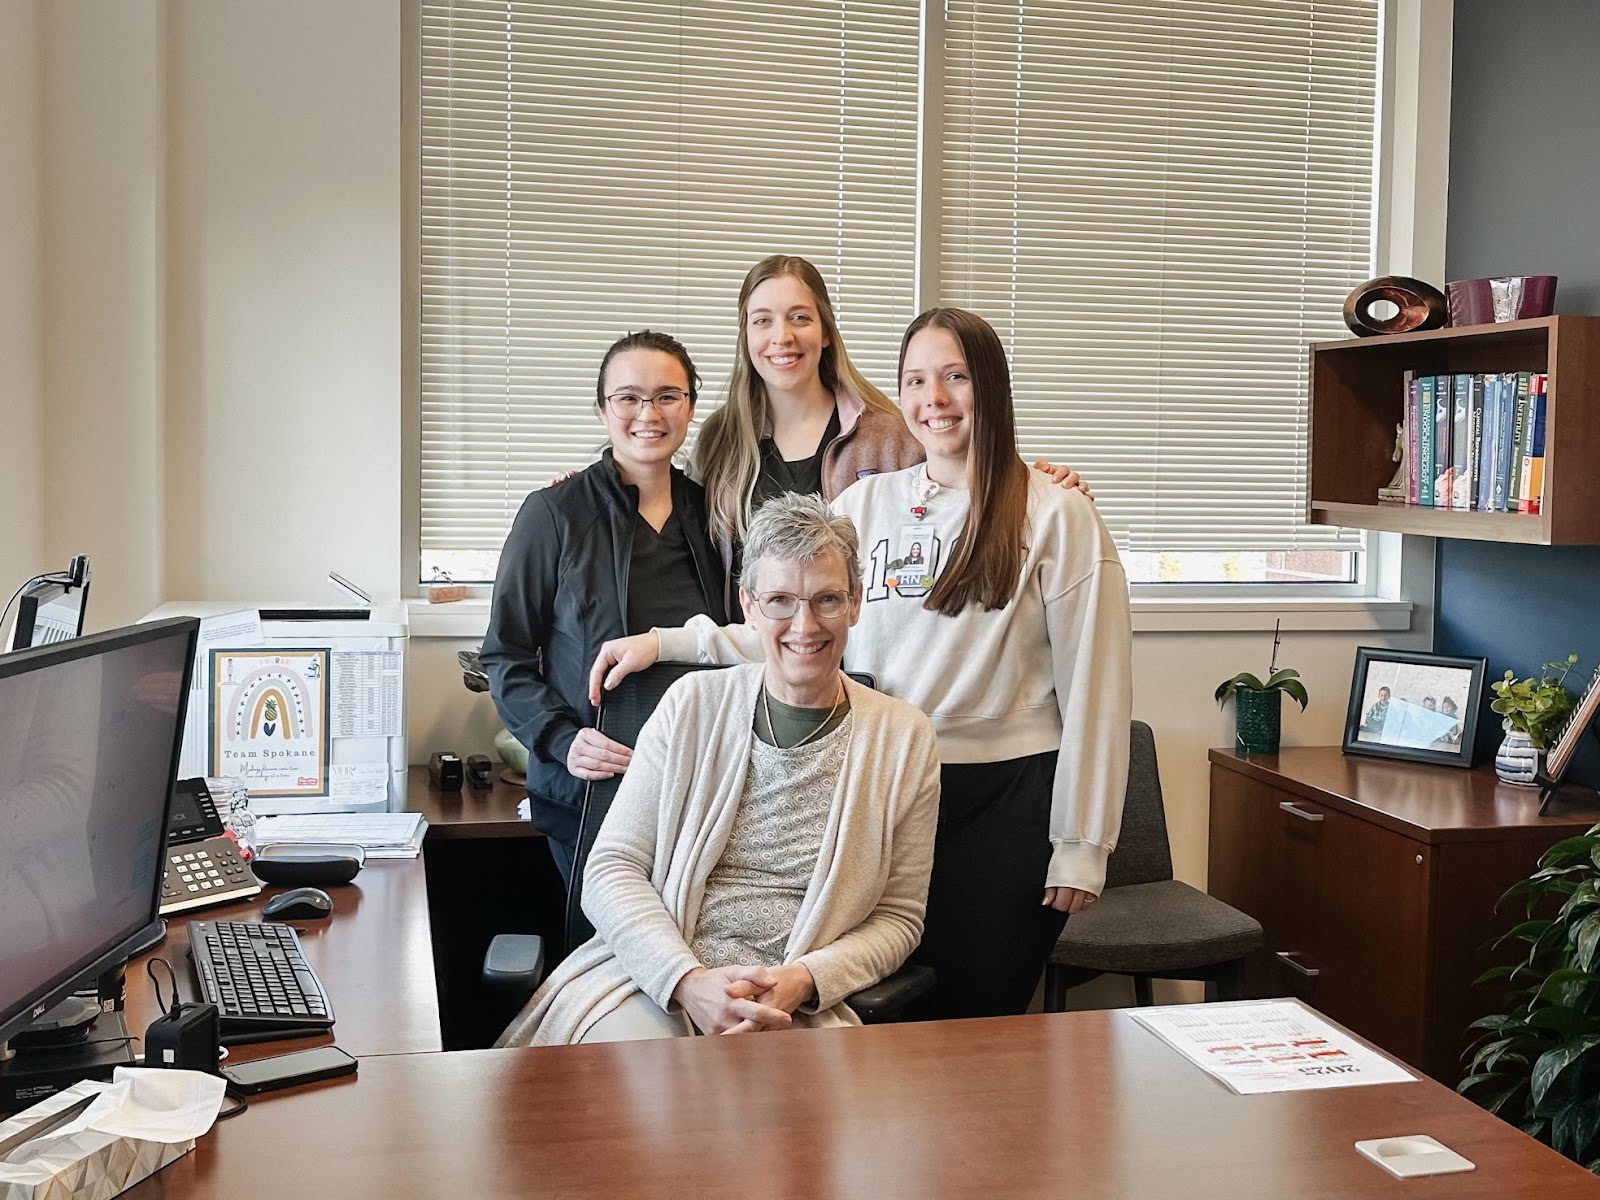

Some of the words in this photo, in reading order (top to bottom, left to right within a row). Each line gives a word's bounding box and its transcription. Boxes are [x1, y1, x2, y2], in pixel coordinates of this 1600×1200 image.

[1514, 399, 1526, 443] INFERTILITY
[900, 575, 920, 585] RN
[224, 750, 257, 758] Team
[263, 749, 316, 759] Spokane
[1298, 1065, 1360, 1075] 2025
